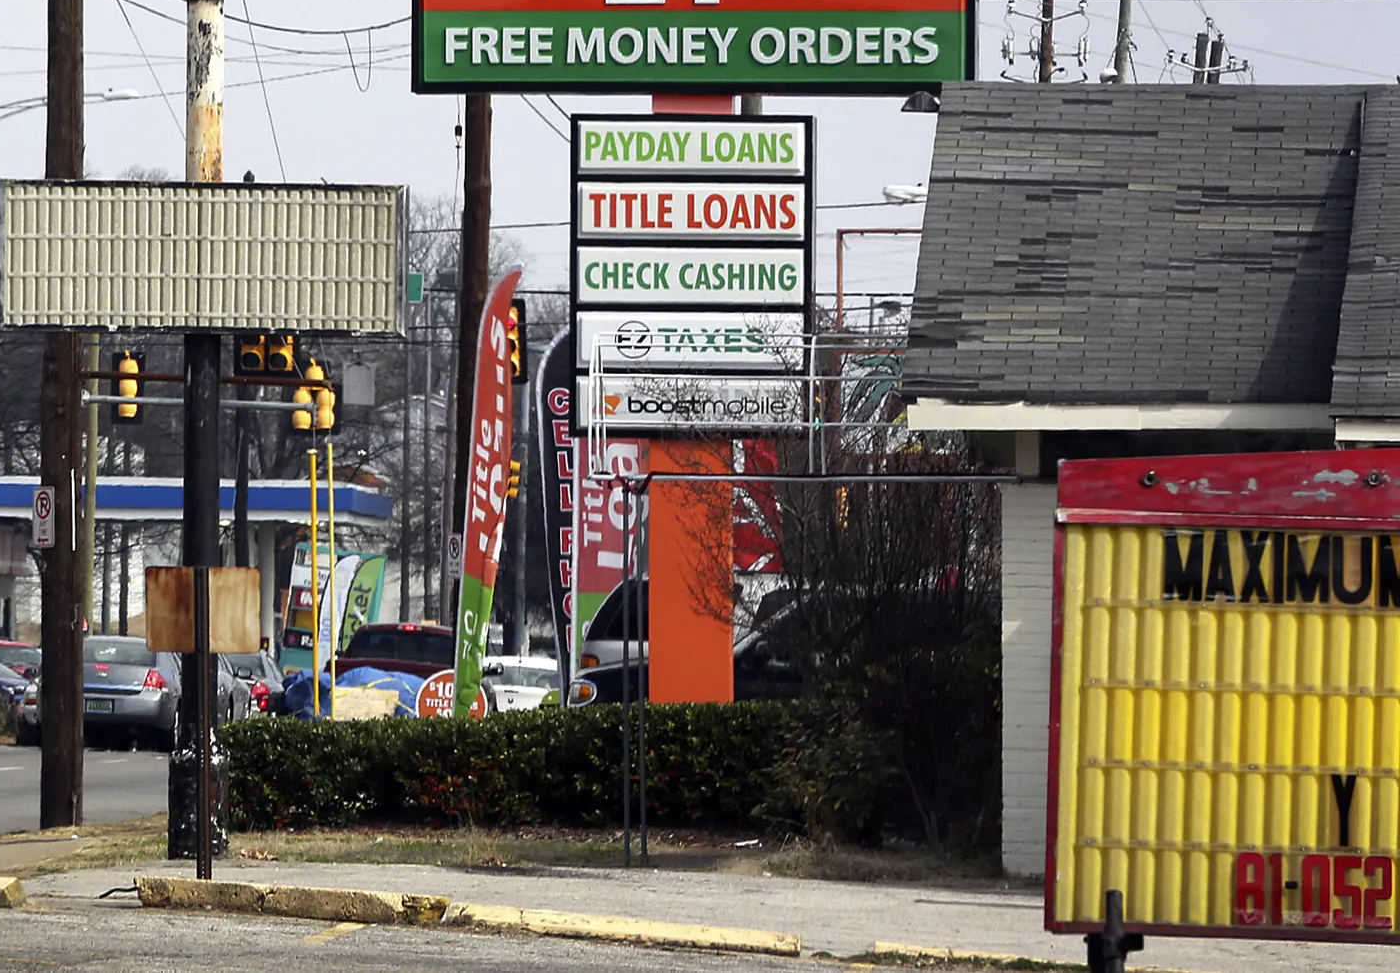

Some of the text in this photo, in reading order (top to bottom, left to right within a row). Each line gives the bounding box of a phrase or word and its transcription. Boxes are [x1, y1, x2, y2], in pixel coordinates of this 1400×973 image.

[444, 27, 939, 65] FREE MONEY ORDERS
[584, 131, 795, 164] PAYDAY LOANS
[589, 193, 797, 230] TITLE LOANS
[584, 262, 798, 292] CHECK CASHING
[657, 327, 766, 353] TAXES
[1329, 773, 1358, 847] Y
